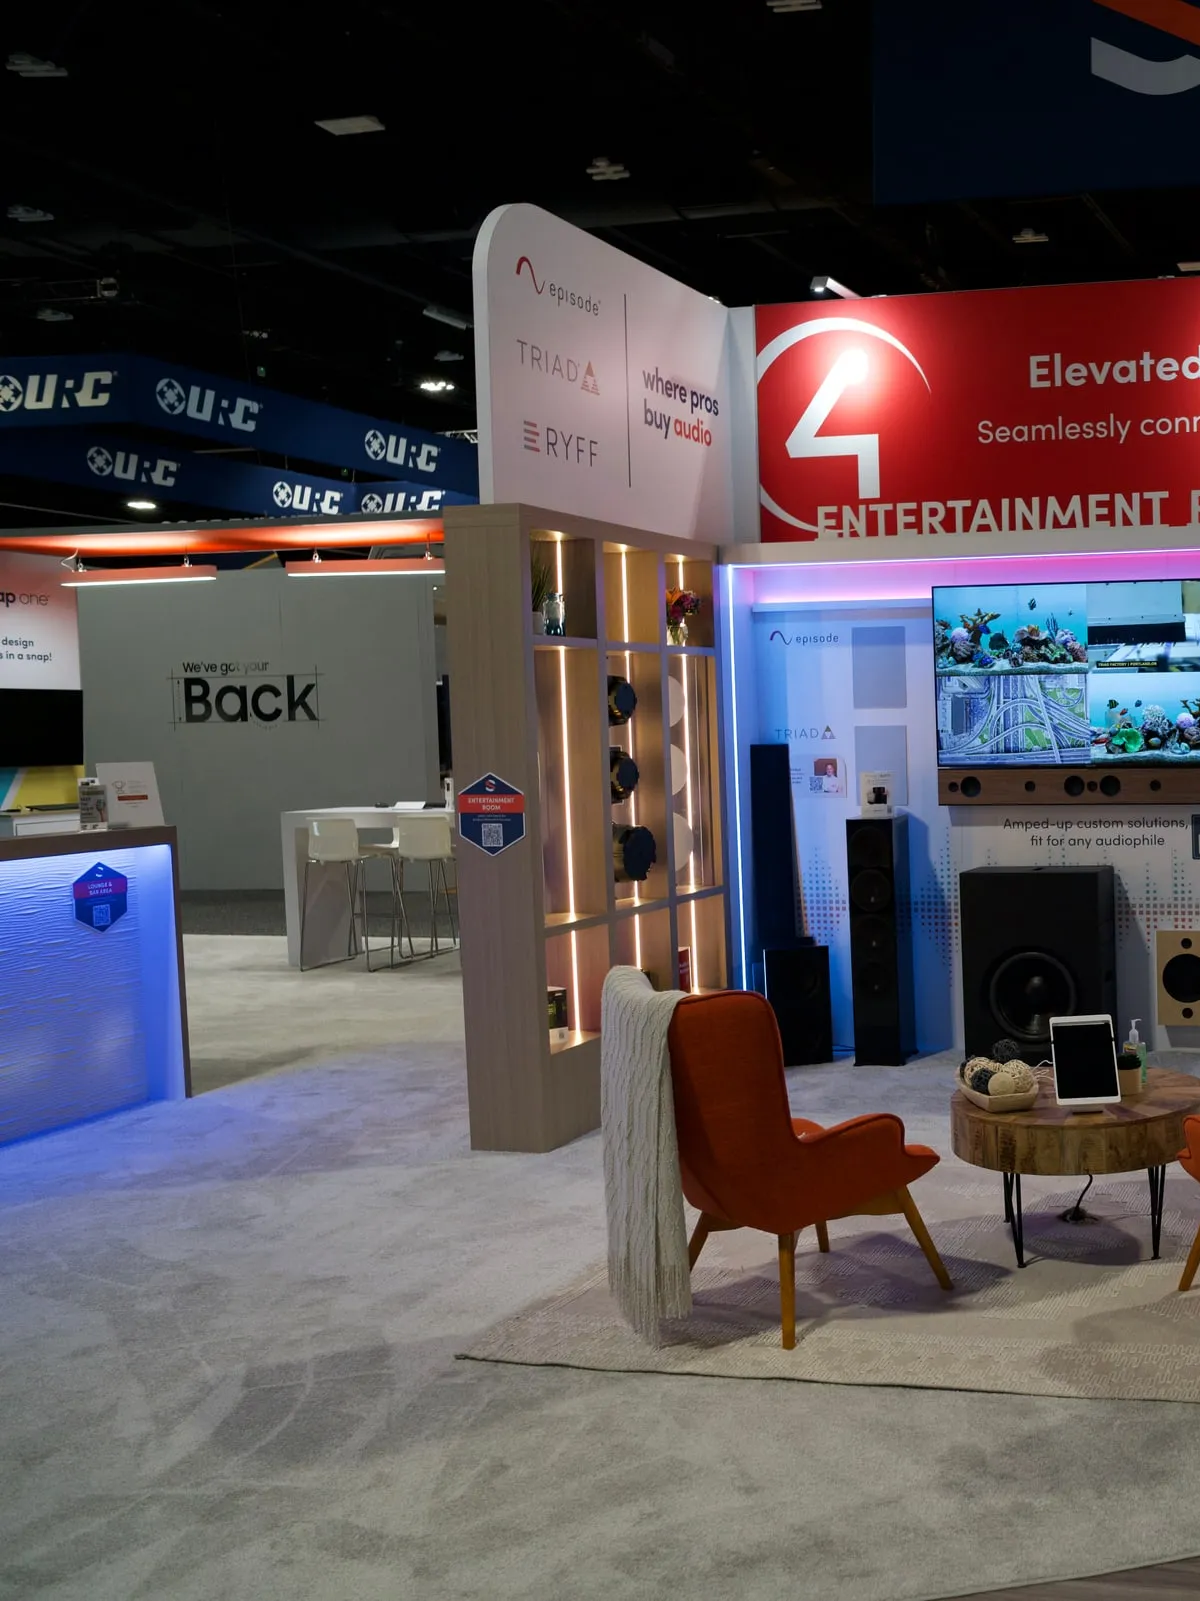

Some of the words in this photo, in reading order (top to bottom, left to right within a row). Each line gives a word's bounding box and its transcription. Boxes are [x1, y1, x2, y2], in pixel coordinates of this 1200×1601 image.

[550, 282, 599, 316] episode
[517, 339, 578, 382] TRIAD
[642, 367, 687, 404] where
[690, 389, 719, 417] pros
[644, 398, 671, 440] buy
[674, 418, 712, 447] audio
[977, 413, 1131, 444] Seamlessly
[546, 427, 598, 467] RYFF
[816, 491, 1170, 540] ENTERTAINMENT
[19, 593, 49, 607] one
[1, 636, 34, 650] design
[795, 633, 839, 646] episode
[6, 651, 15, 660] in
[26, 652, 52, 663] snap!
[220, 661, 240, 676] got
[243, 660, 270, 676] your
[184, 674, 318, 722] Back
[775, 728, 819, 740] TRIAD
[1003, 817, 1073, 832] Amped-up
[1076, 818, 1124, 830] custom
[1127, 816, 1189, 830] solutions,
[1030, 835, 1044, 847] fit
[1046, 835, 1065, 847] for
[1068, 837, 1092, 849] any
[1095, 834, 1165, 848] audiophile
